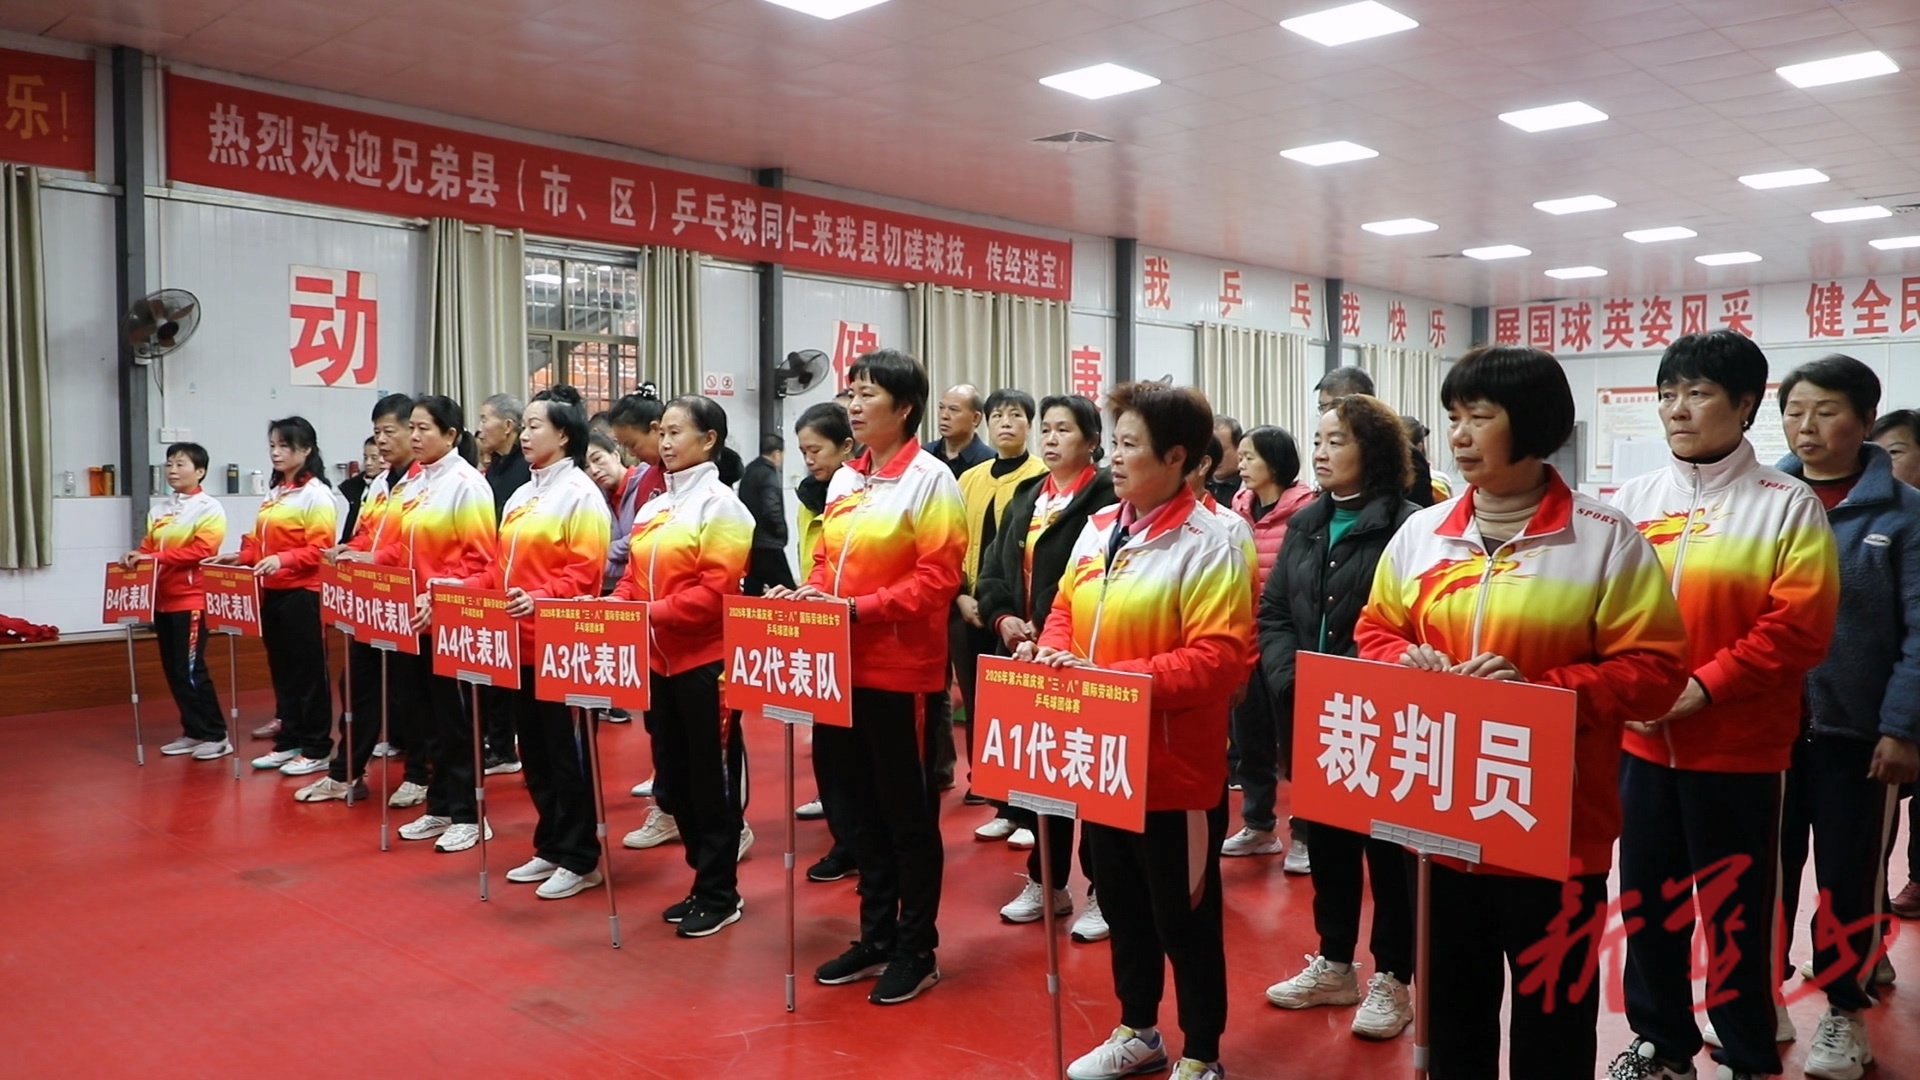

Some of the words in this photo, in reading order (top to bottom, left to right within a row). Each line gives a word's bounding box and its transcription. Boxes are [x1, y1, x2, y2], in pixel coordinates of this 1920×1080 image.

[290, 270, 378, 386] 动
[1576, 508, 1619, 526] SPORT
[106, 584, 150, 611] B4代表队
[206, 592, 256, 623] B3代表队
[355, 596, 413, 637] B1代表队
[437, 624, 513, 670] A4代表队
[540, 641, 642, 689] A3代表队
[732, 646, 842, 703] A2代表队
[1034, 693, 1081, 714] 乒乓球团体赛
[981, 718, 1134, 800] A1代表队
[1316, 692, 1538, 832] 裁判员
